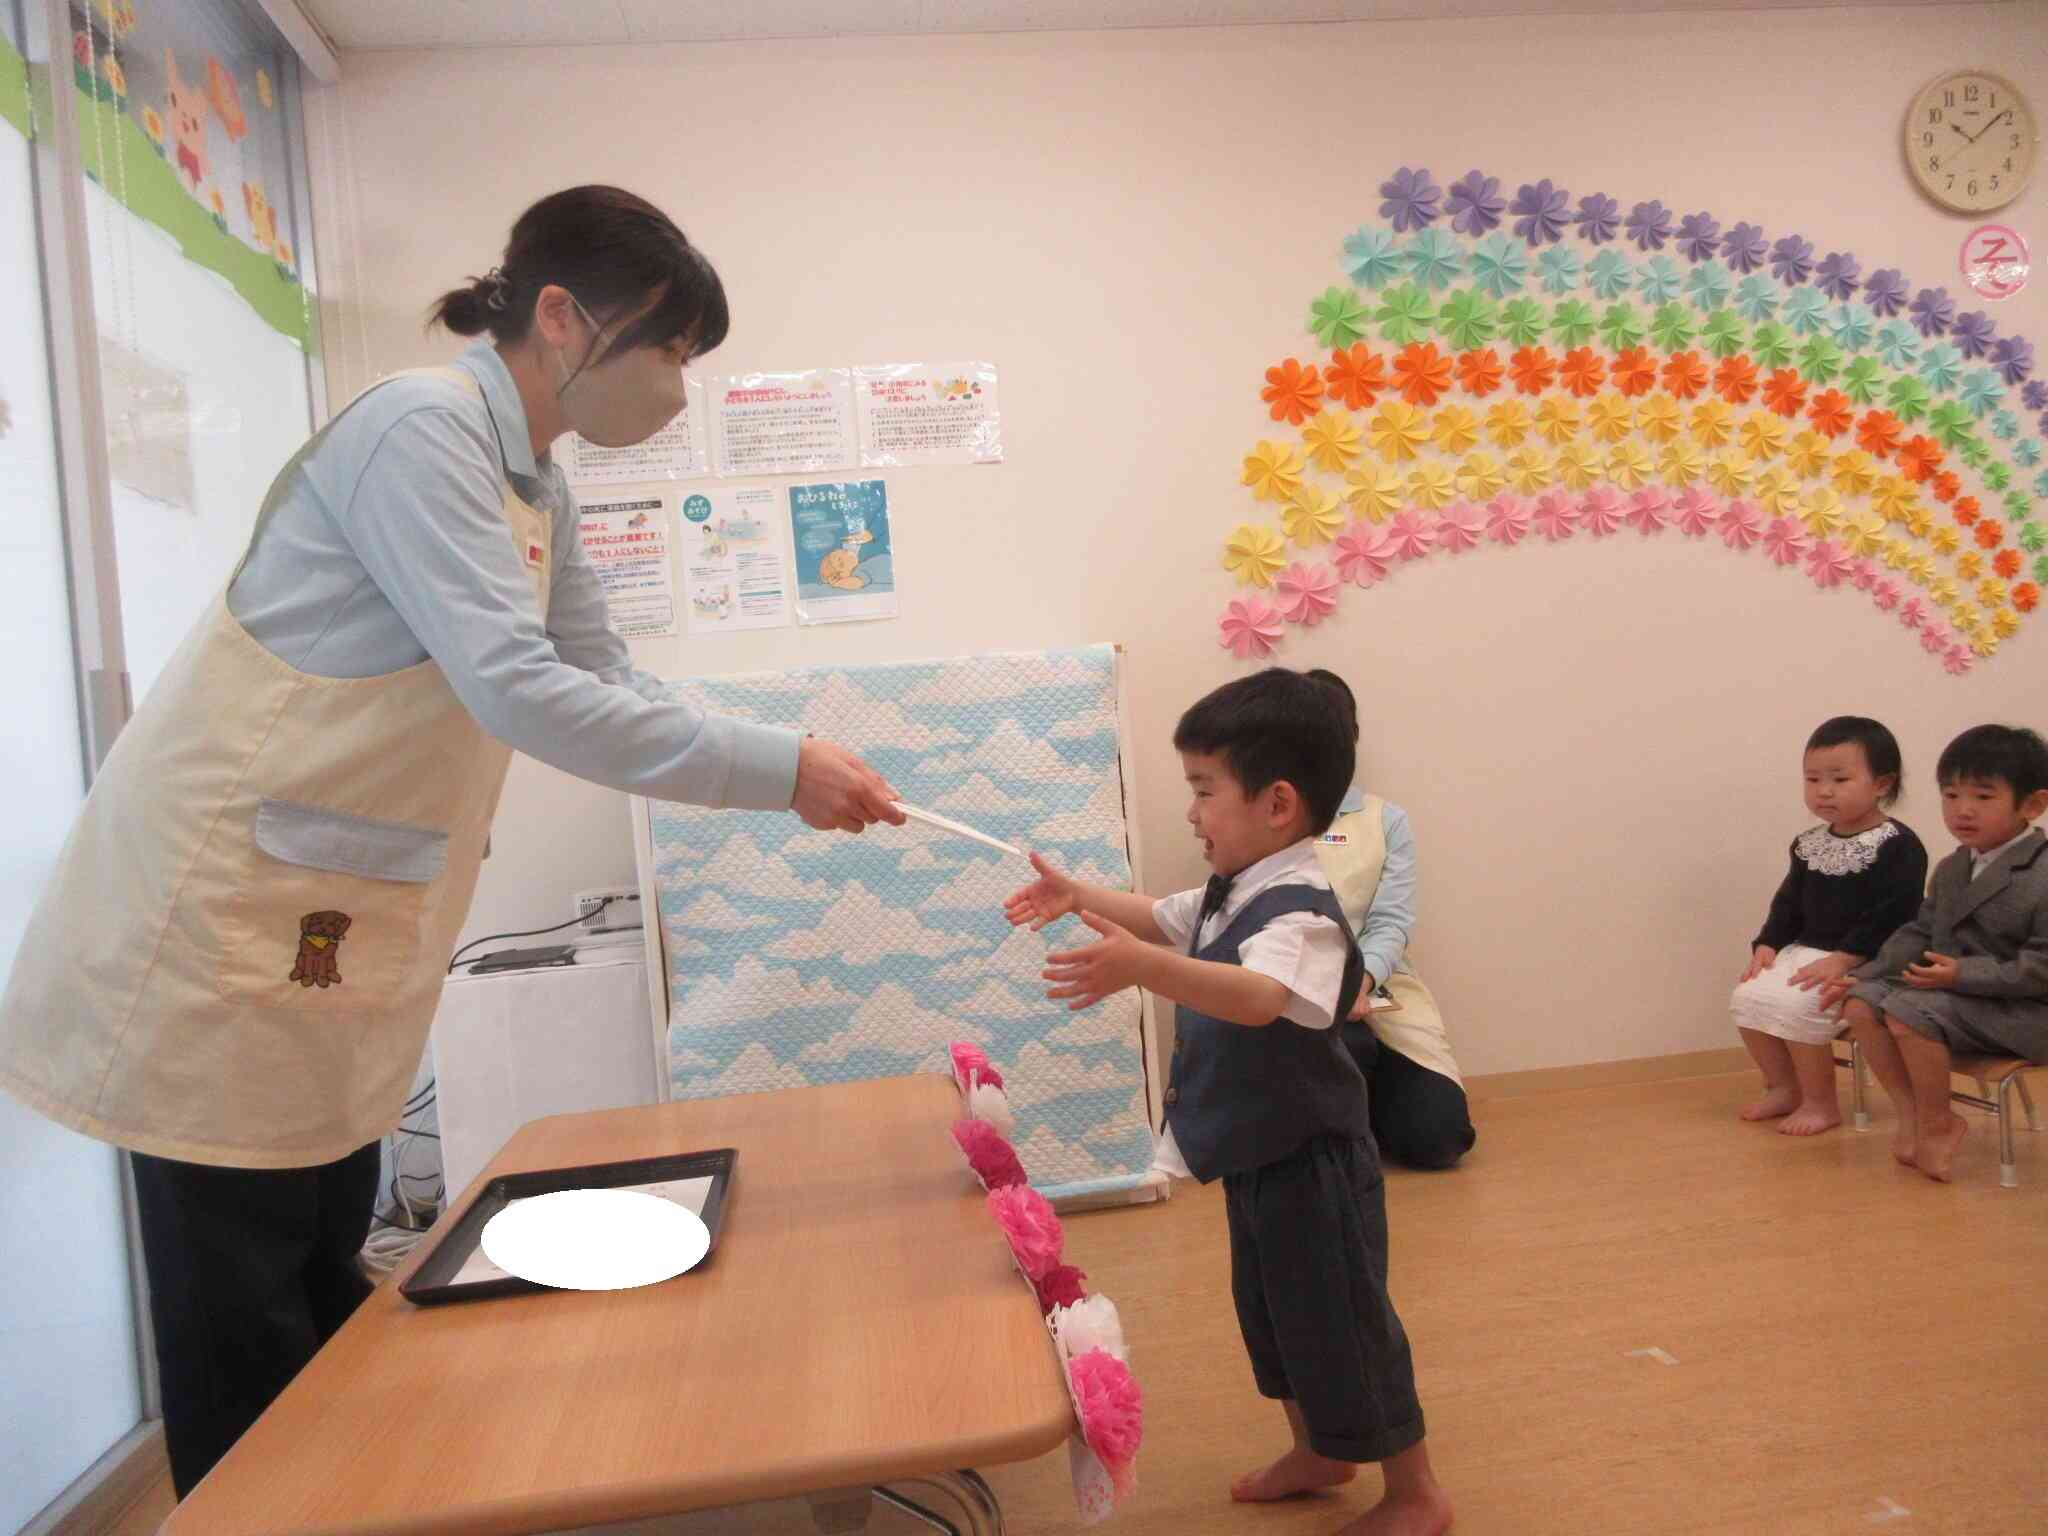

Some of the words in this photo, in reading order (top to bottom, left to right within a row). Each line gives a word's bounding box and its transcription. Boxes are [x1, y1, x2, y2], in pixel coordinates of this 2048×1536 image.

[1944, 92, 1953, 107] 11
[1963, 85, 1978, 101] 12
[1989, 94, 1995, 107] 1
[1929, 109, 1941, 124] 10
[2003, 112, 2013, 125] 2
[1923, 132, 1933, 147] 9
[2010, 134, 2019, 149] 3
[1929, 157, 1939, 171] 8
[2002, 157, 2012, 171] 4
[1946, 174, 1956, 190] 7
[1967, 180, 1977, 195] 6
[1990, 175, 1999, 190] 5
